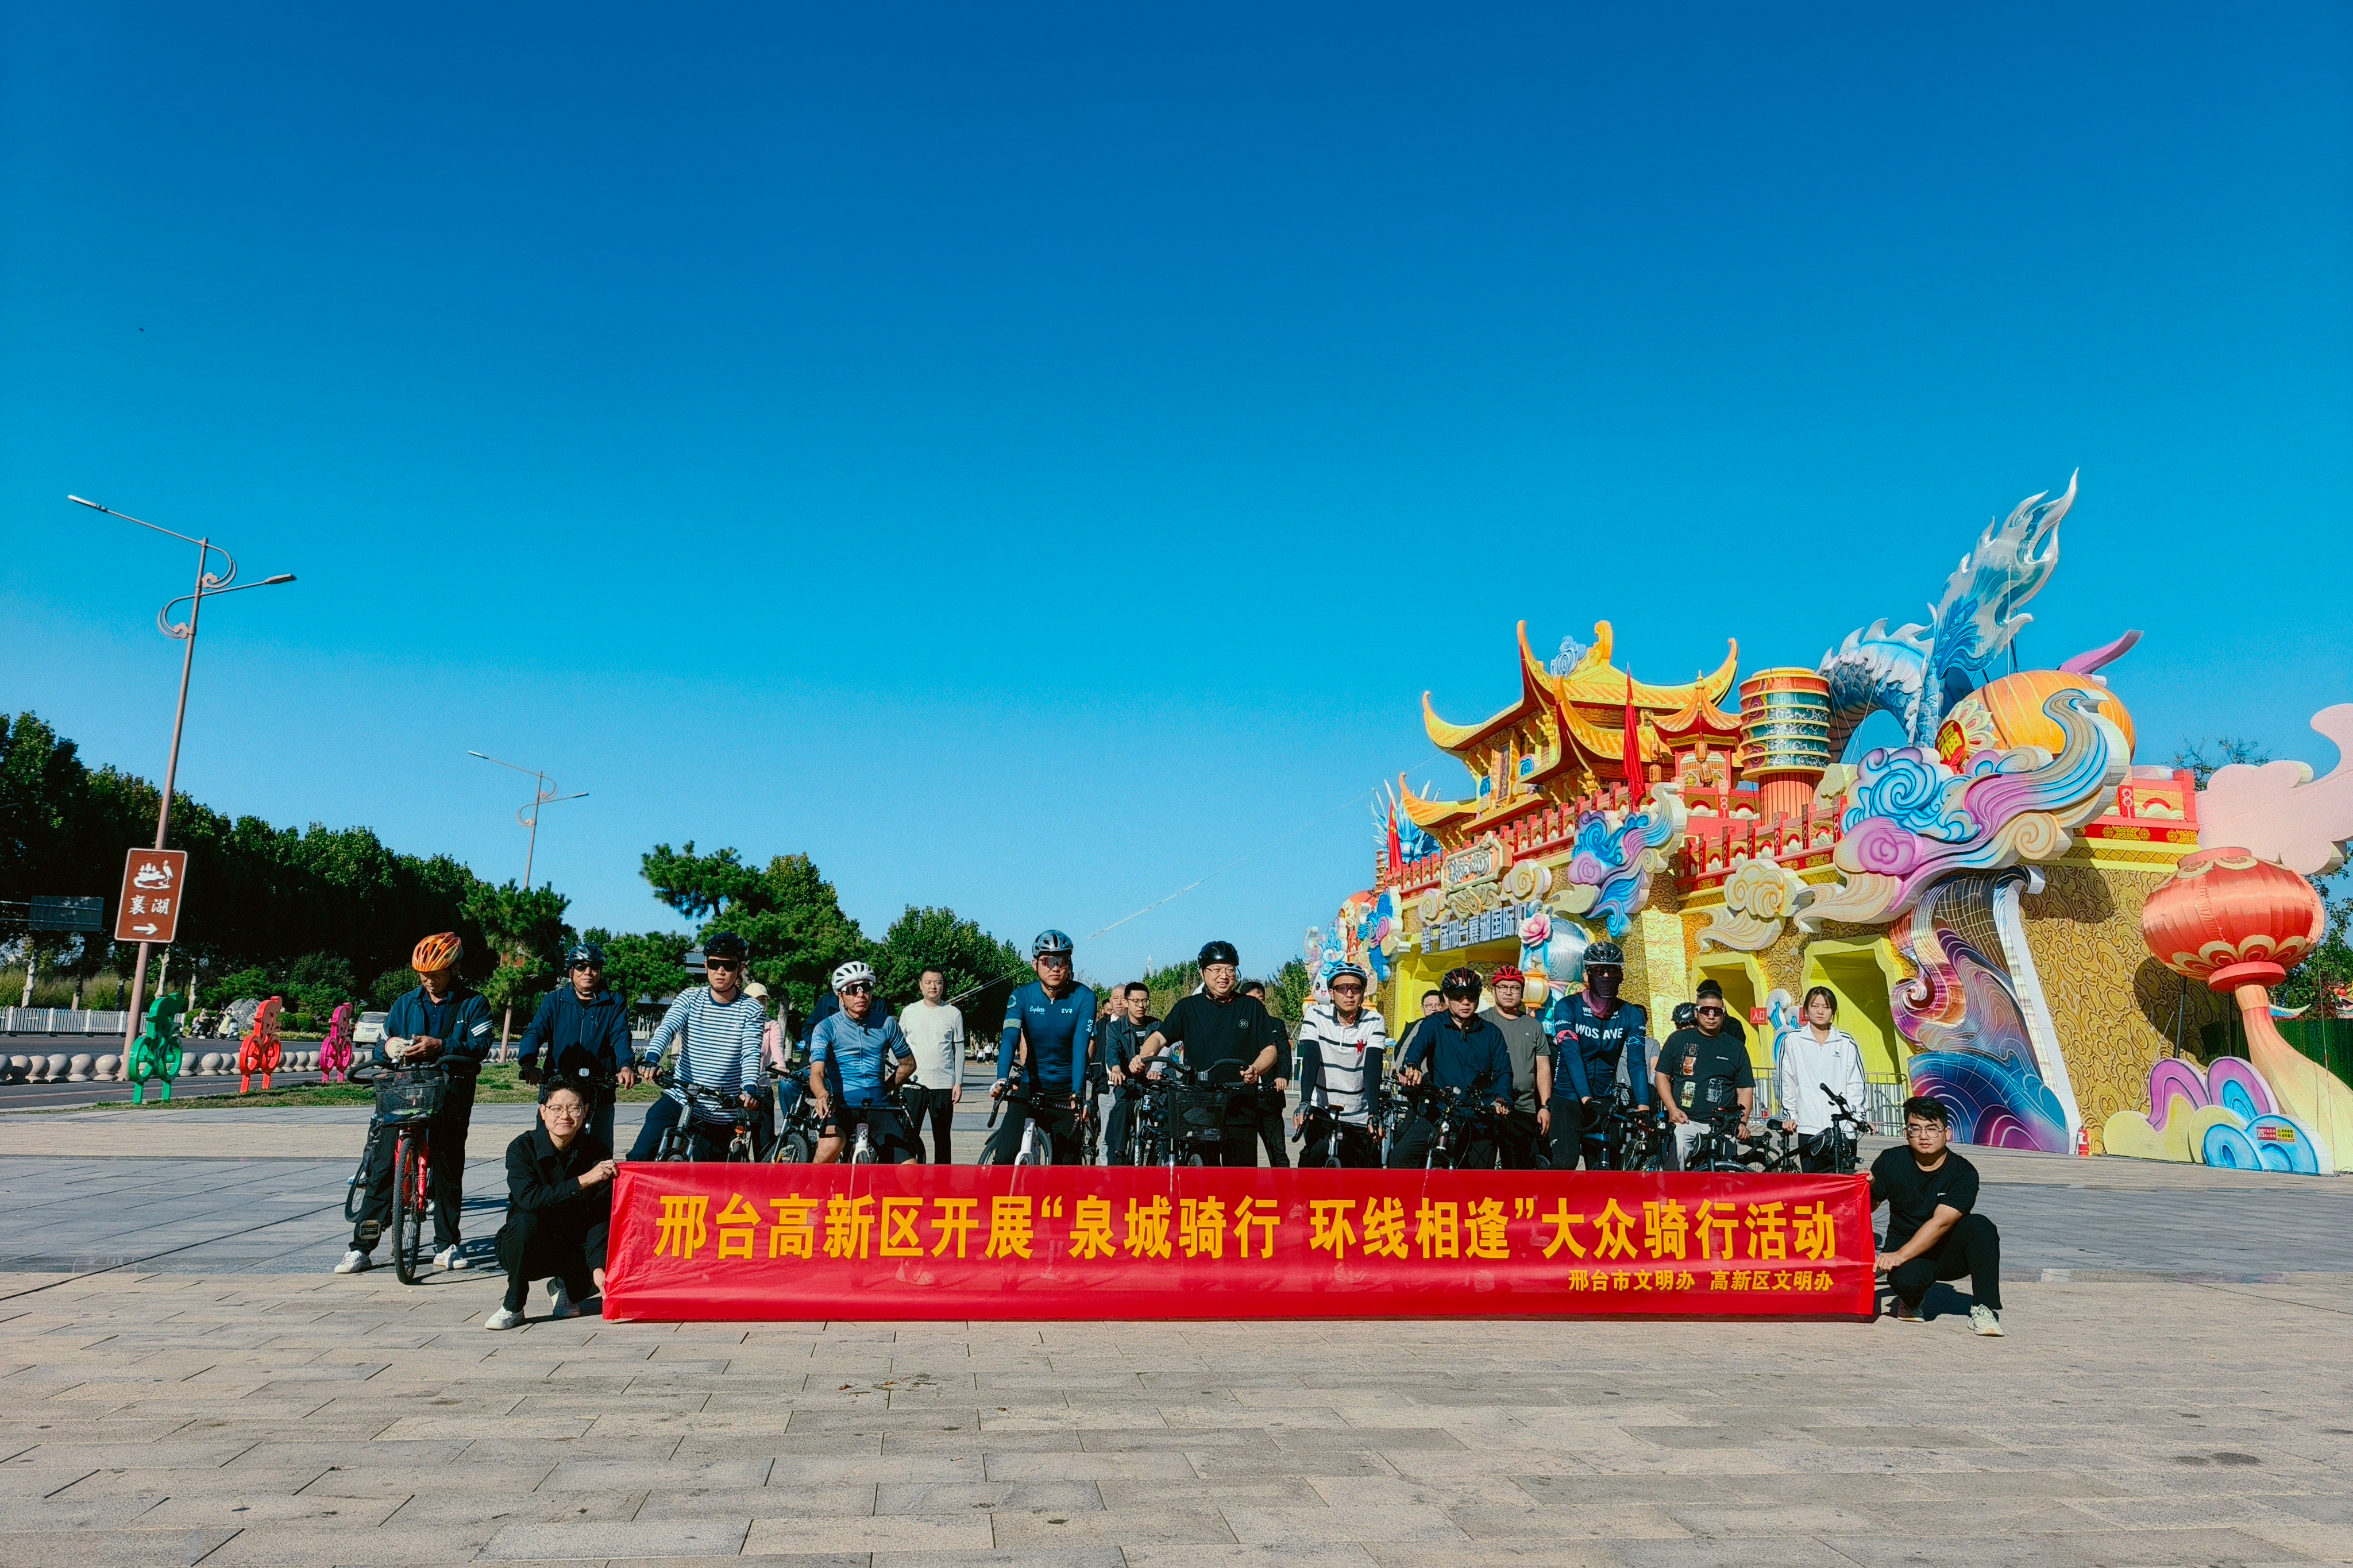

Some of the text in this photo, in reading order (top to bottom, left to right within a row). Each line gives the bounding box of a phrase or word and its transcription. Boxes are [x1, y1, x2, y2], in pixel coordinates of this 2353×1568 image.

[1937, 721, 1962, 760] 福
[128, 894, 170, 915] 襄湖
[1753, 1011, 1765, 1021] 入口
[654, 1192, 1836, 1261] 邢台高新区开展“泉城骑行 环线相逢”大众骑行活动
[1568, 1269, 1834, 1292] 邢台市文明办 高新区文明办
